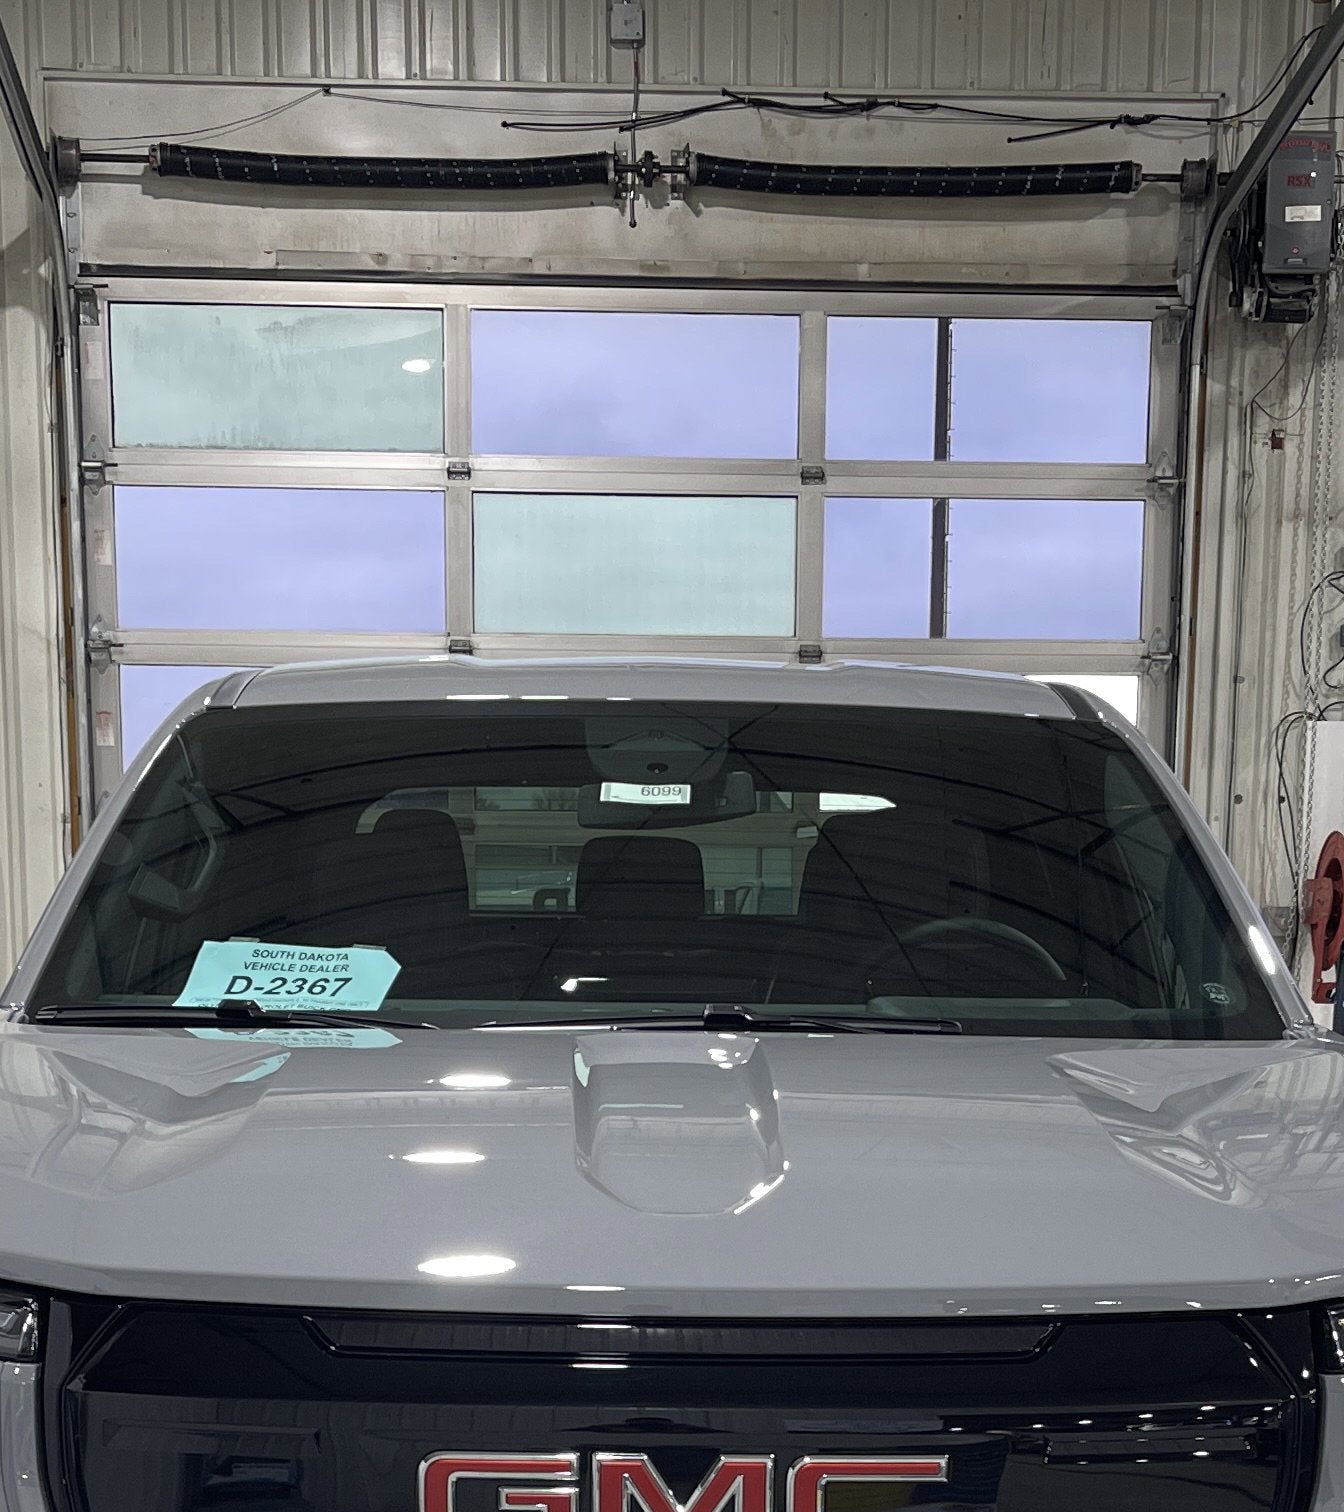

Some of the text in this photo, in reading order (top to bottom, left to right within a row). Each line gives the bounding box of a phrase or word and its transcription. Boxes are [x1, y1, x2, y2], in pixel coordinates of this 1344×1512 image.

[1287, 175, 1312, 188] RSX
[640, 786, 682, 797] 6099
[251, 949, 349, 962] SOUTH DAKOTA
[244, 961, 350, 973] VEHICLE DEALER
[223, 975, 353, 997] D-2367
